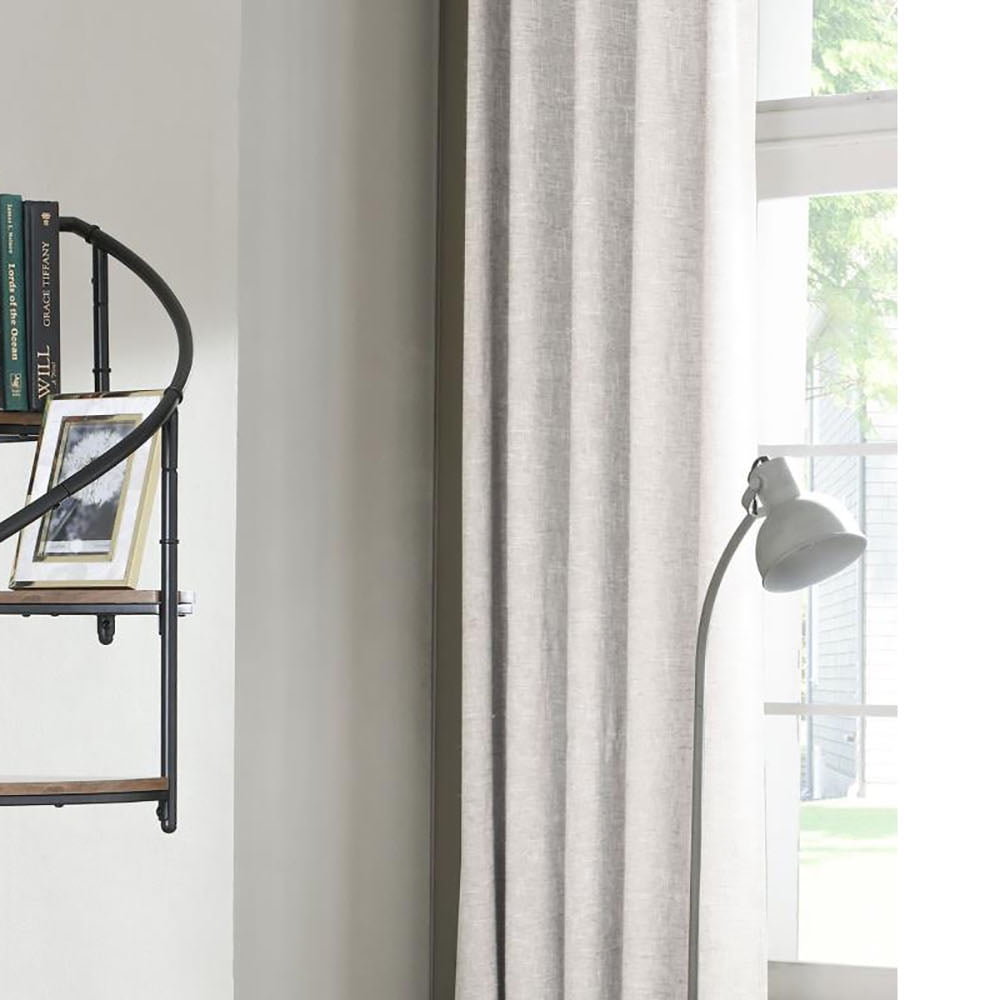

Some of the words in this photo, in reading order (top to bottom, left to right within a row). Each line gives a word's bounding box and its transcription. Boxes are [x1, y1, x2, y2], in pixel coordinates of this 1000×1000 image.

[8, 263, 17, 293] Lords
[42, 241, 50, 288] TIFFANY
[9, 295, 18, 307] of
[9, 308, 19, 325] the
[42, 290, 51, 327] GRACE
[10, 328, 19, 360] Ocean
[37, 345, 51, 400] WILL
